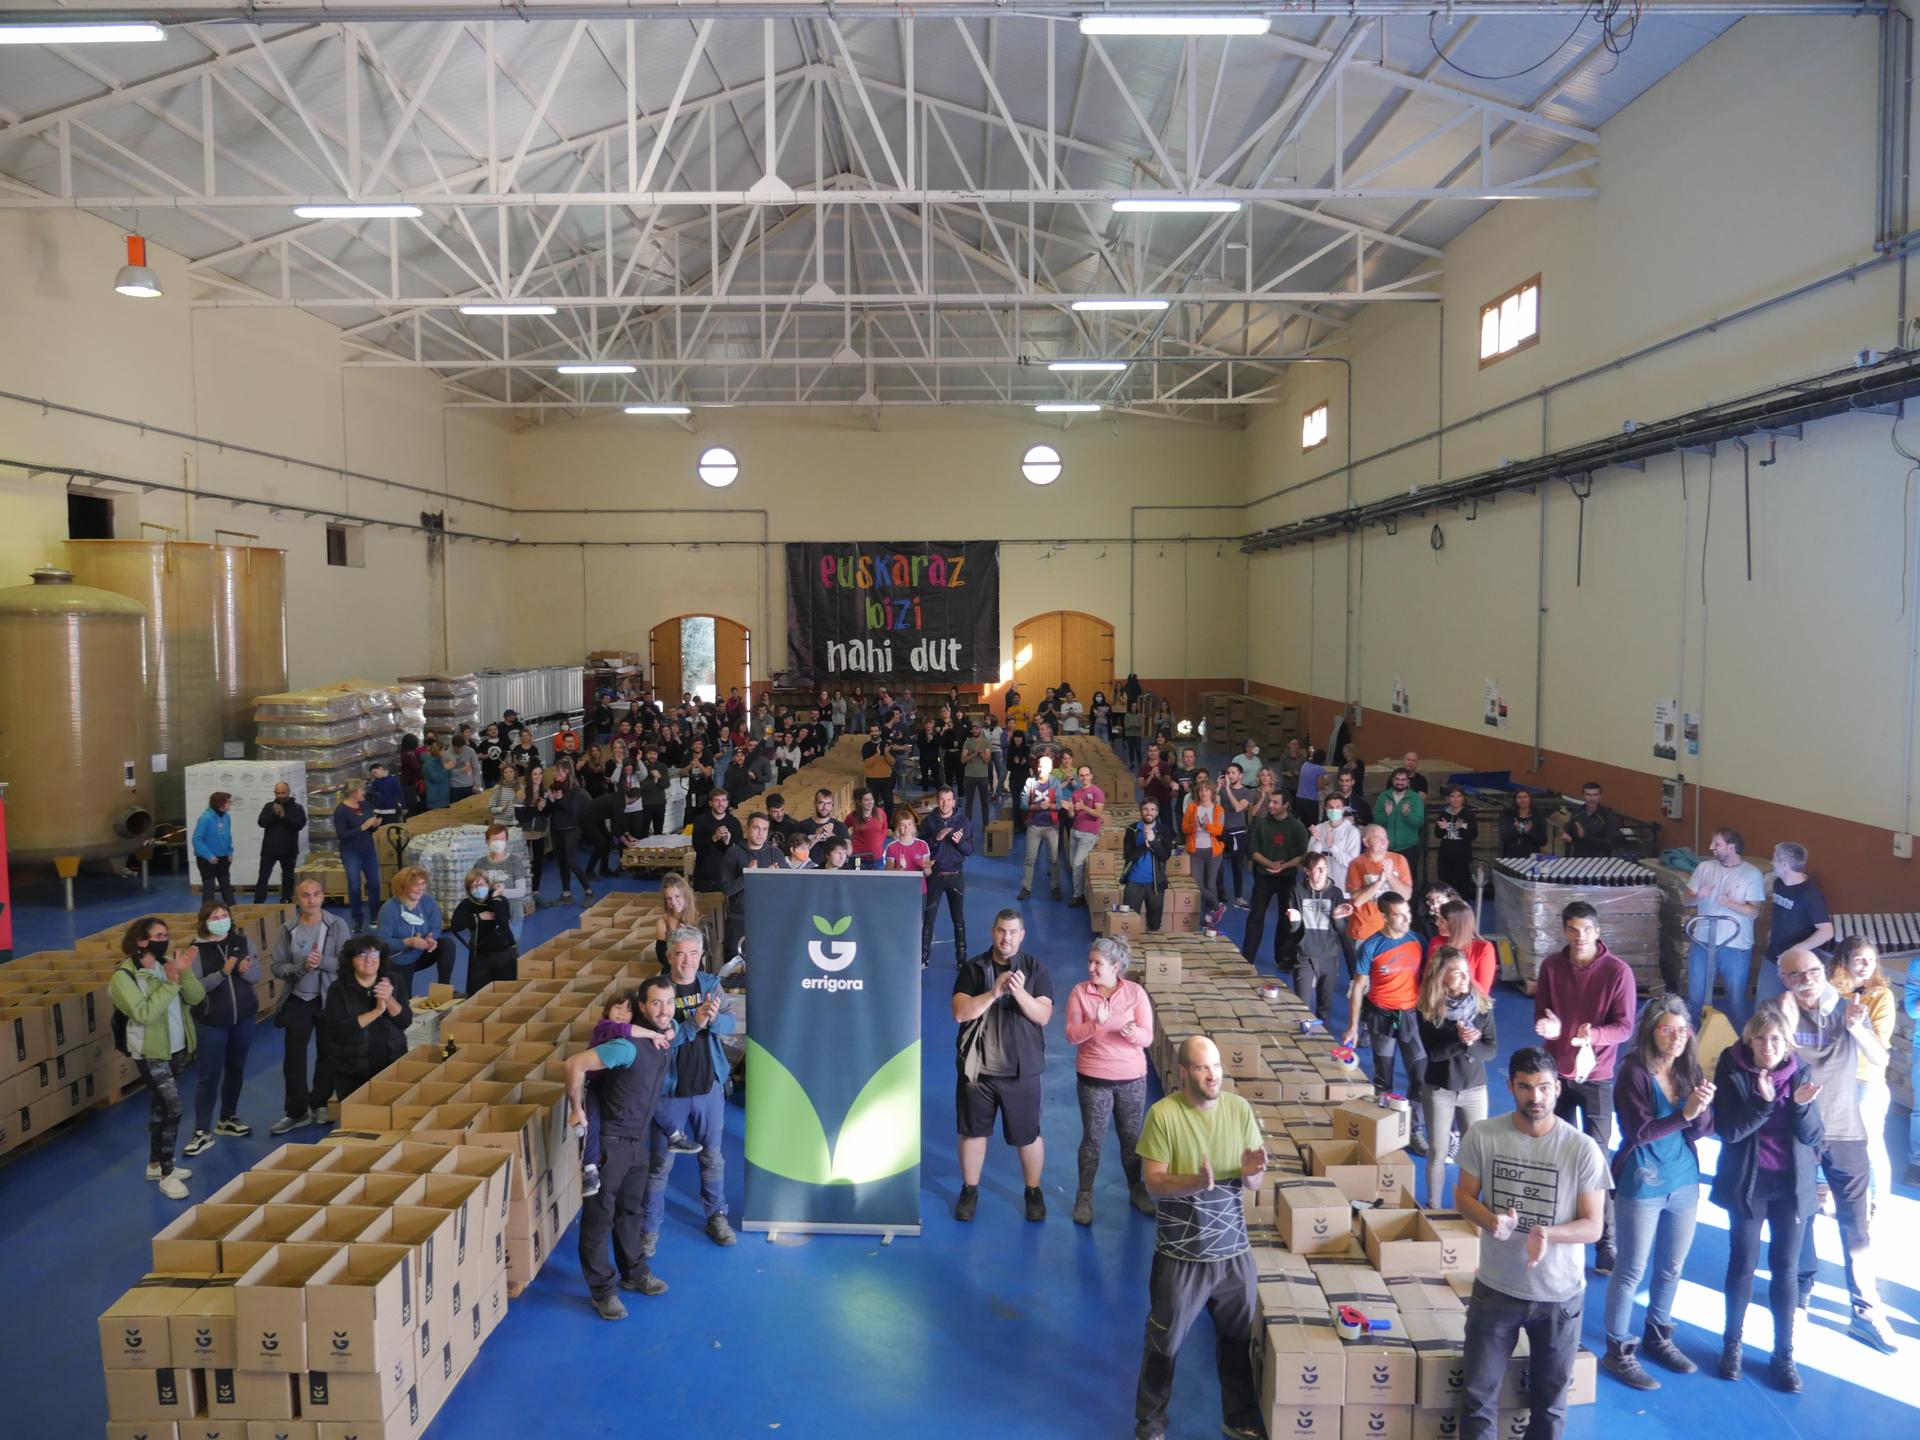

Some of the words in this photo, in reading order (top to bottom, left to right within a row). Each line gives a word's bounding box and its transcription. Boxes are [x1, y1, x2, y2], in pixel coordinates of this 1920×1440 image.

[819, 554, 966, 589] euskaraz
[865, 596, 923, 631] bizi
[826, 638, 893, 673] nahi
[910, 637, 962, 672] dut
[801, 974, 864, 993] errigora
[1496, 1163, 1525, 1179] inor
[1523, 1186, 1541, 1198] ez
[1506, 1196, 1524, 1210] da
